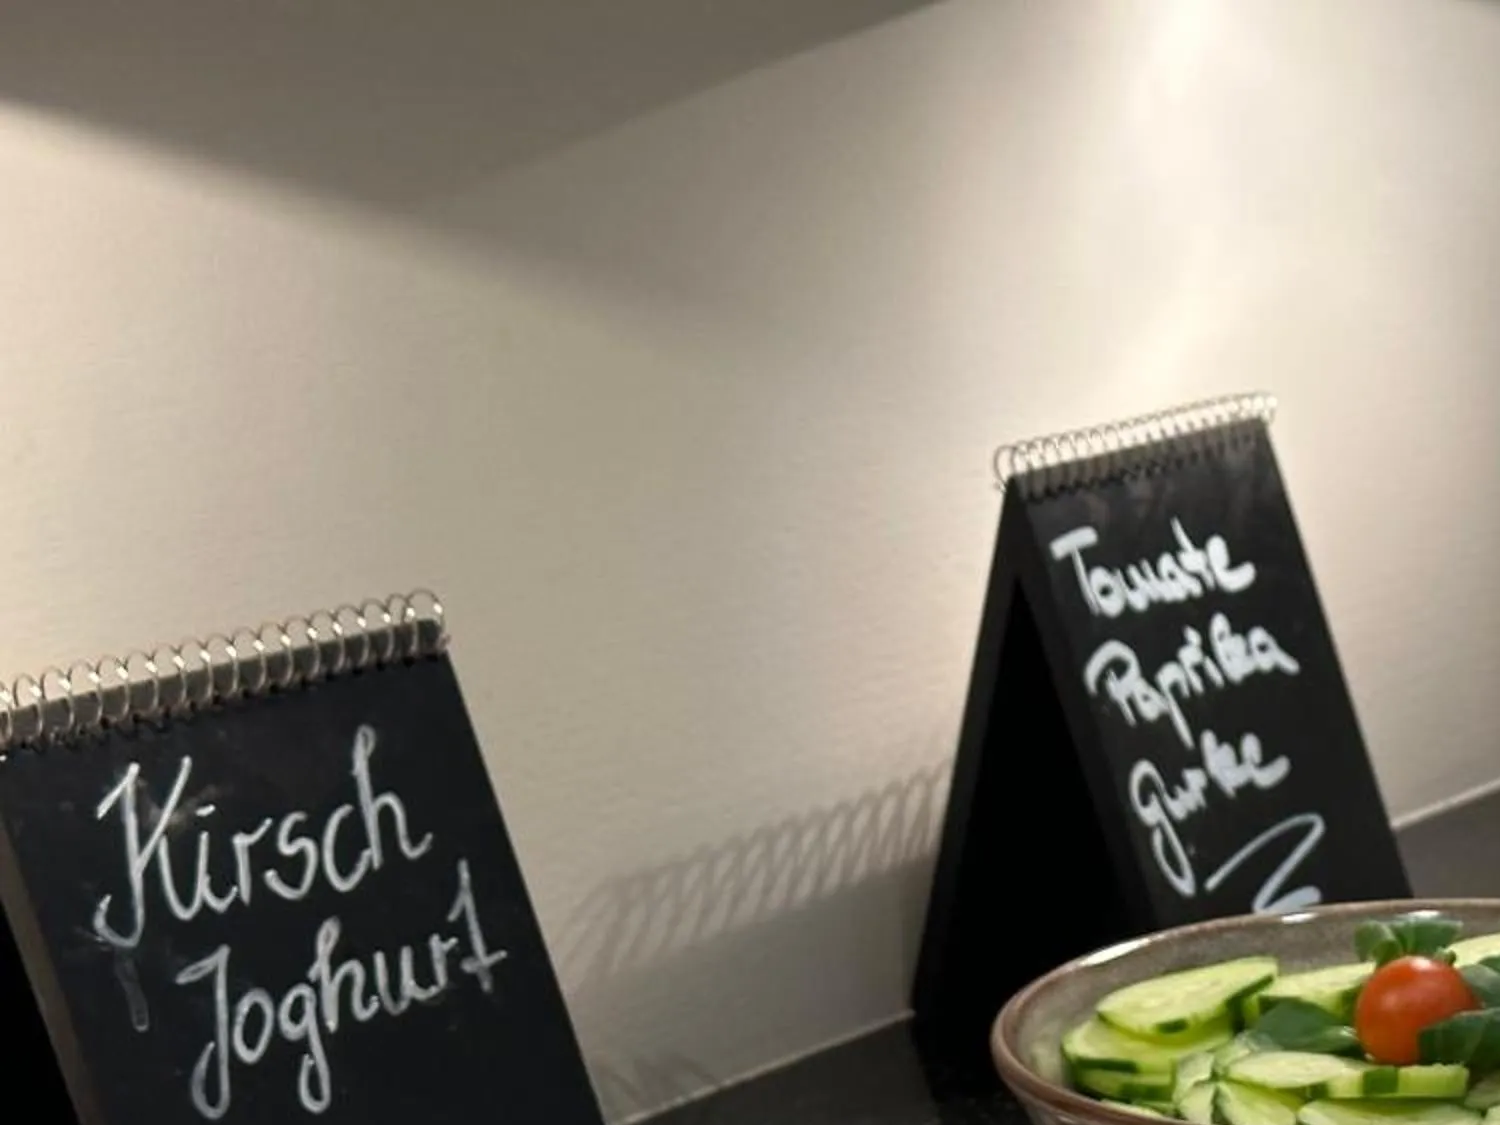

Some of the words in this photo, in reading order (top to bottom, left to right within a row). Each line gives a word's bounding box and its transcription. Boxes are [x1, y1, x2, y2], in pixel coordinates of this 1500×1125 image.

[1049, 517, 1257, 618] Tomate
[1084, 612, 1300, 750] Paprika
[94, 724, 433, 948] Kirsch
[1129, 729, 1291, 897] Gurke
[176, 858, 508, 1120] Joghurt
